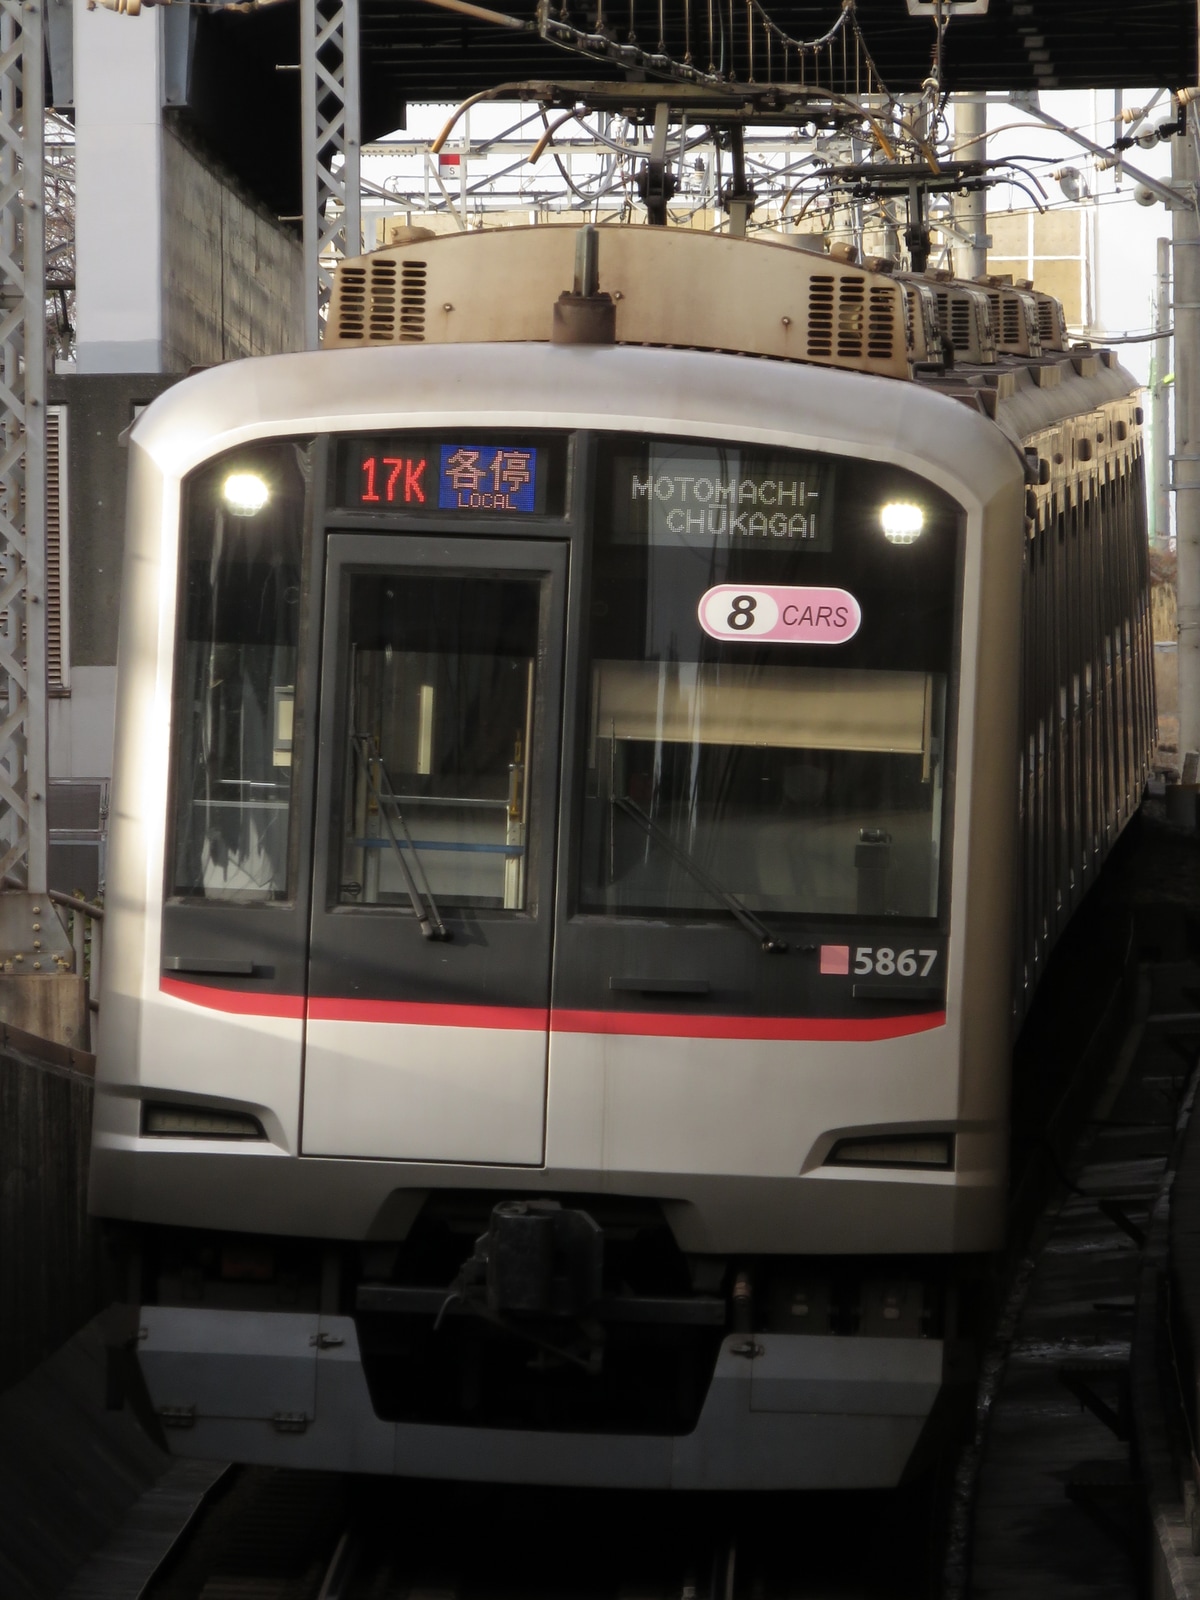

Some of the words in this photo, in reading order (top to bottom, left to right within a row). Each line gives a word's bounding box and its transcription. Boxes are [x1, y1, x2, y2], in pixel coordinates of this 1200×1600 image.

[449, 166, 456, 175] S
[362, 457, 426, 503] 17K
[446, 449, 531, 492] 各停
[458, 493, 516, 509] LOCAL
[632, 475, 819, 506] MOTOMACHI-
[667, 504, 815, 538] CHŪKAGAI
[727, 595, 757, 630] 8
[782, 605, 848, 628] CARS
[854, 947, 938, 977] 5867
